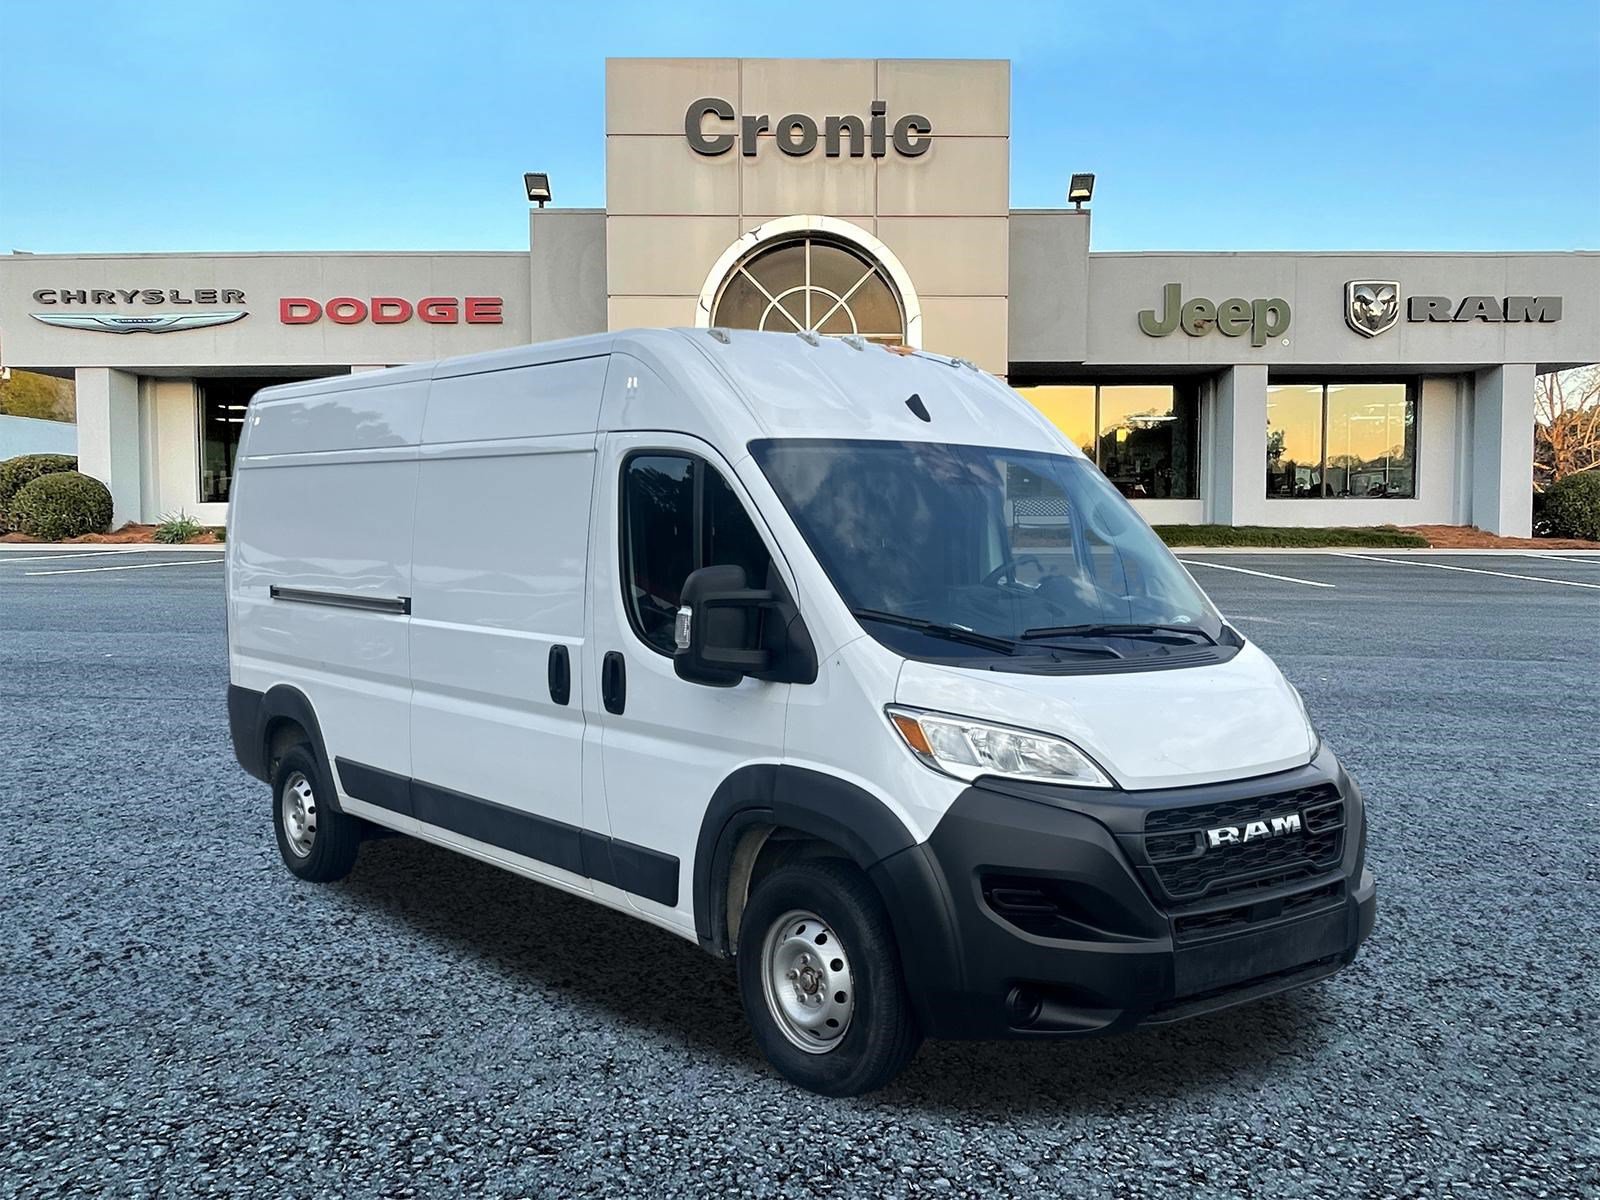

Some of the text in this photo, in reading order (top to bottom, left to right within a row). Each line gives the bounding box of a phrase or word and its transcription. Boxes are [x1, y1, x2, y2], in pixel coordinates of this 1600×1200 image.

[685, 97, 932, 157] Cronic
[32, 289, 247, 305] CHRYSLER
[280, 297, 503, 325] DODGE
[1407, 296, 1562, 323] RAM
[1138, 283, 1291, 347] Jeep
[1208, 814, 1302, 848] RAM
